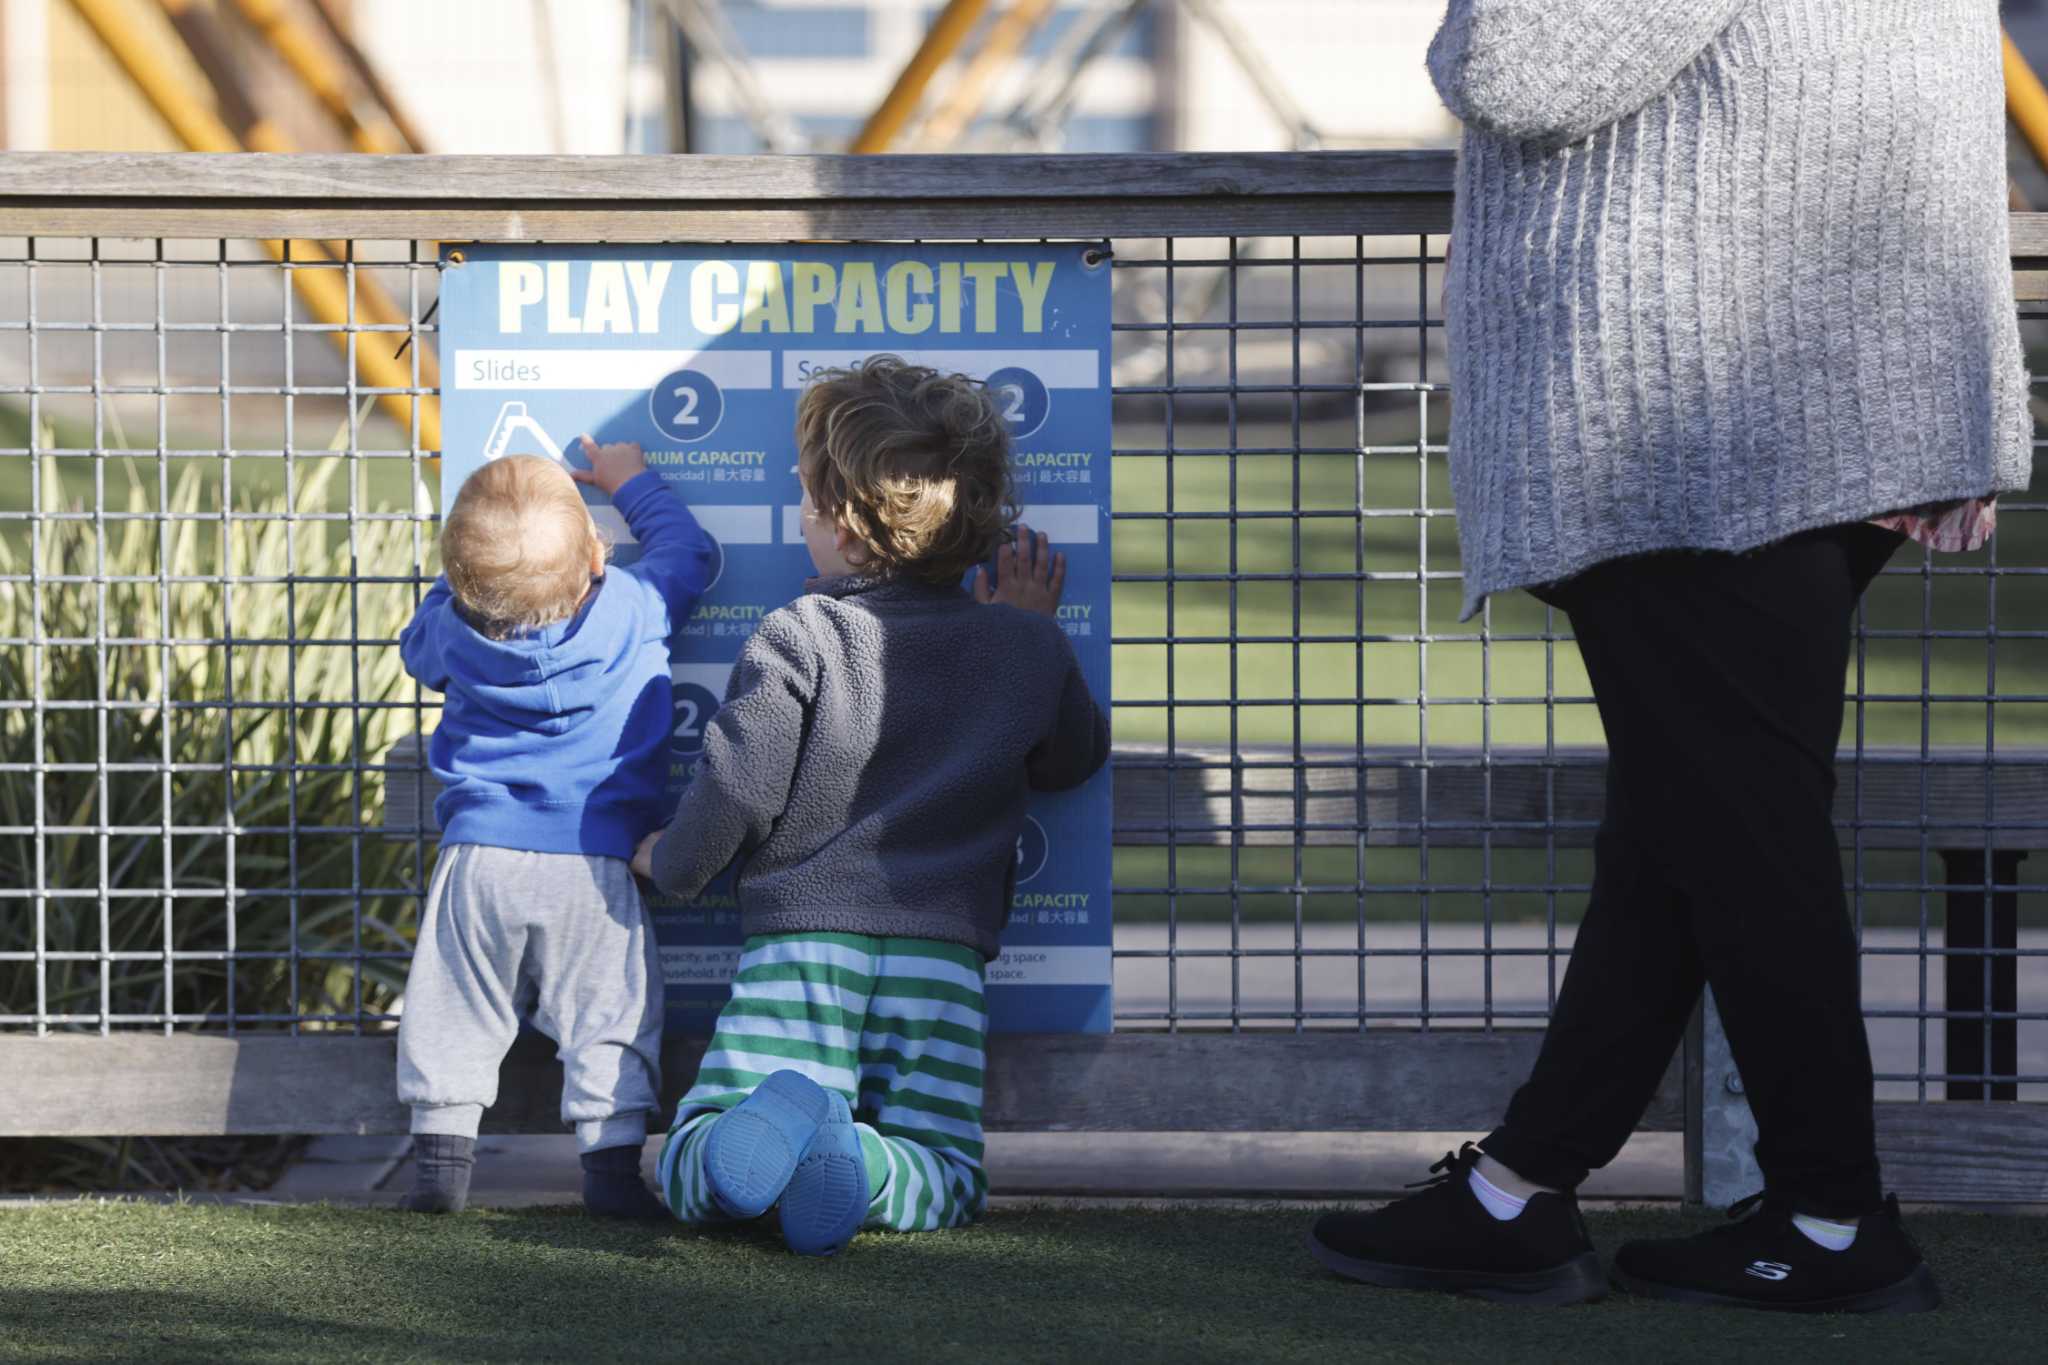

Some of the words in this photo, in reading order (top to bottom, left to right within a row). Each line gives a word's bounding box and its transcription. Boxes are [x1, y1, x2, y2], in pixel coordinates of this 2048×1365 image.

[499, 260, 672, 334] PLAY
[690, 259, 1057, 335] CAPACITY
[472, 358, 541, 381] Slides
[672, 385, 700, 425] 2
[1000, 383, 1025, 422] 2
[643, 451, 685, 465] MUM
[687, 451, 767, 465] CAPACITY
[1014, 452, 1092, 467] CAPACITY
[1055, 604, 1092, 619] CITY
[673, 698, 700, 737] 2
[1012, 893, 1089, 908] CAPACITY
[1013, 953, 1047, 965] space
